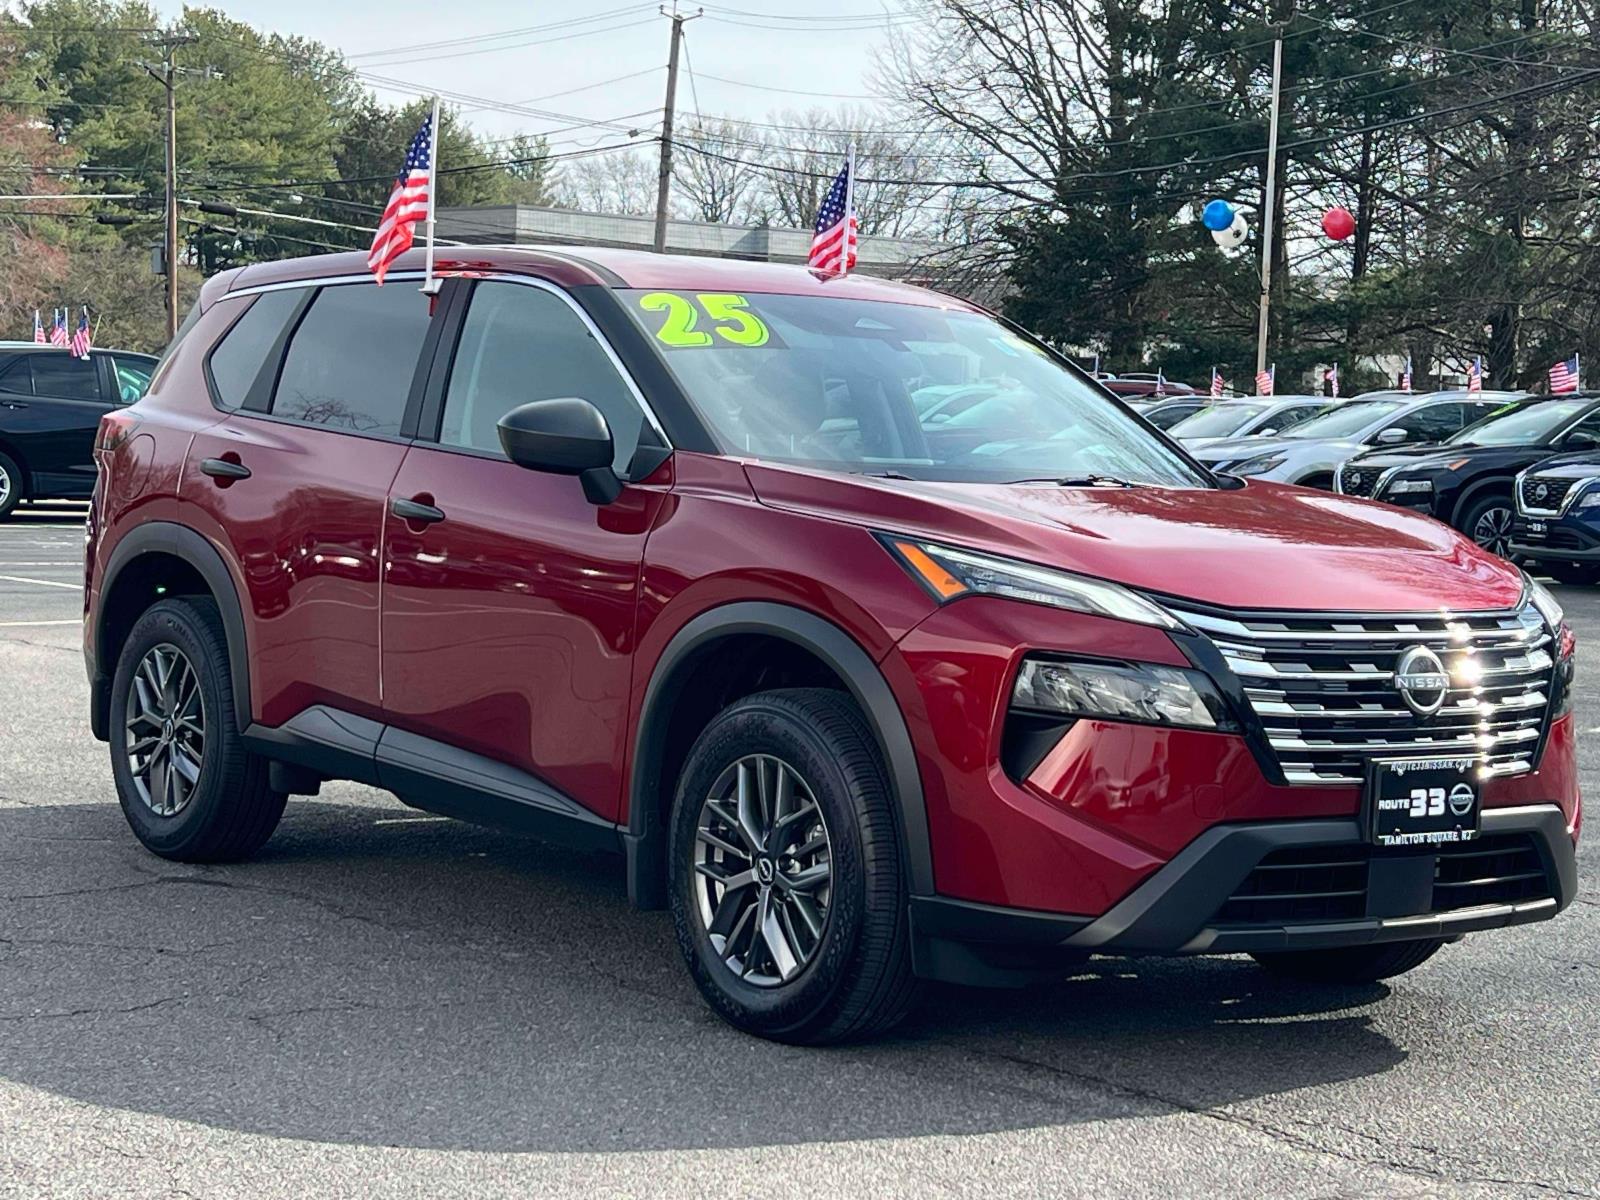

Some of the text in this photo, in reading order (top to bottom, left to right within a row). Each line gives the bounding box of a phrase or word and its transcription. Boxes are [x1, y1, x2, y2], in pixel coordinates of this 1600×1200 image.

[639, 292, 770, 347] 25
[1397, 677, 1450, 689] NISSAN
[1378, 799, 1410, 810] ROUTE
[1409, 787, 1446, 817] 33
[1384, 834, 1425, 846] HAMILTON
[1461, 831, 1472, 841] NJ
